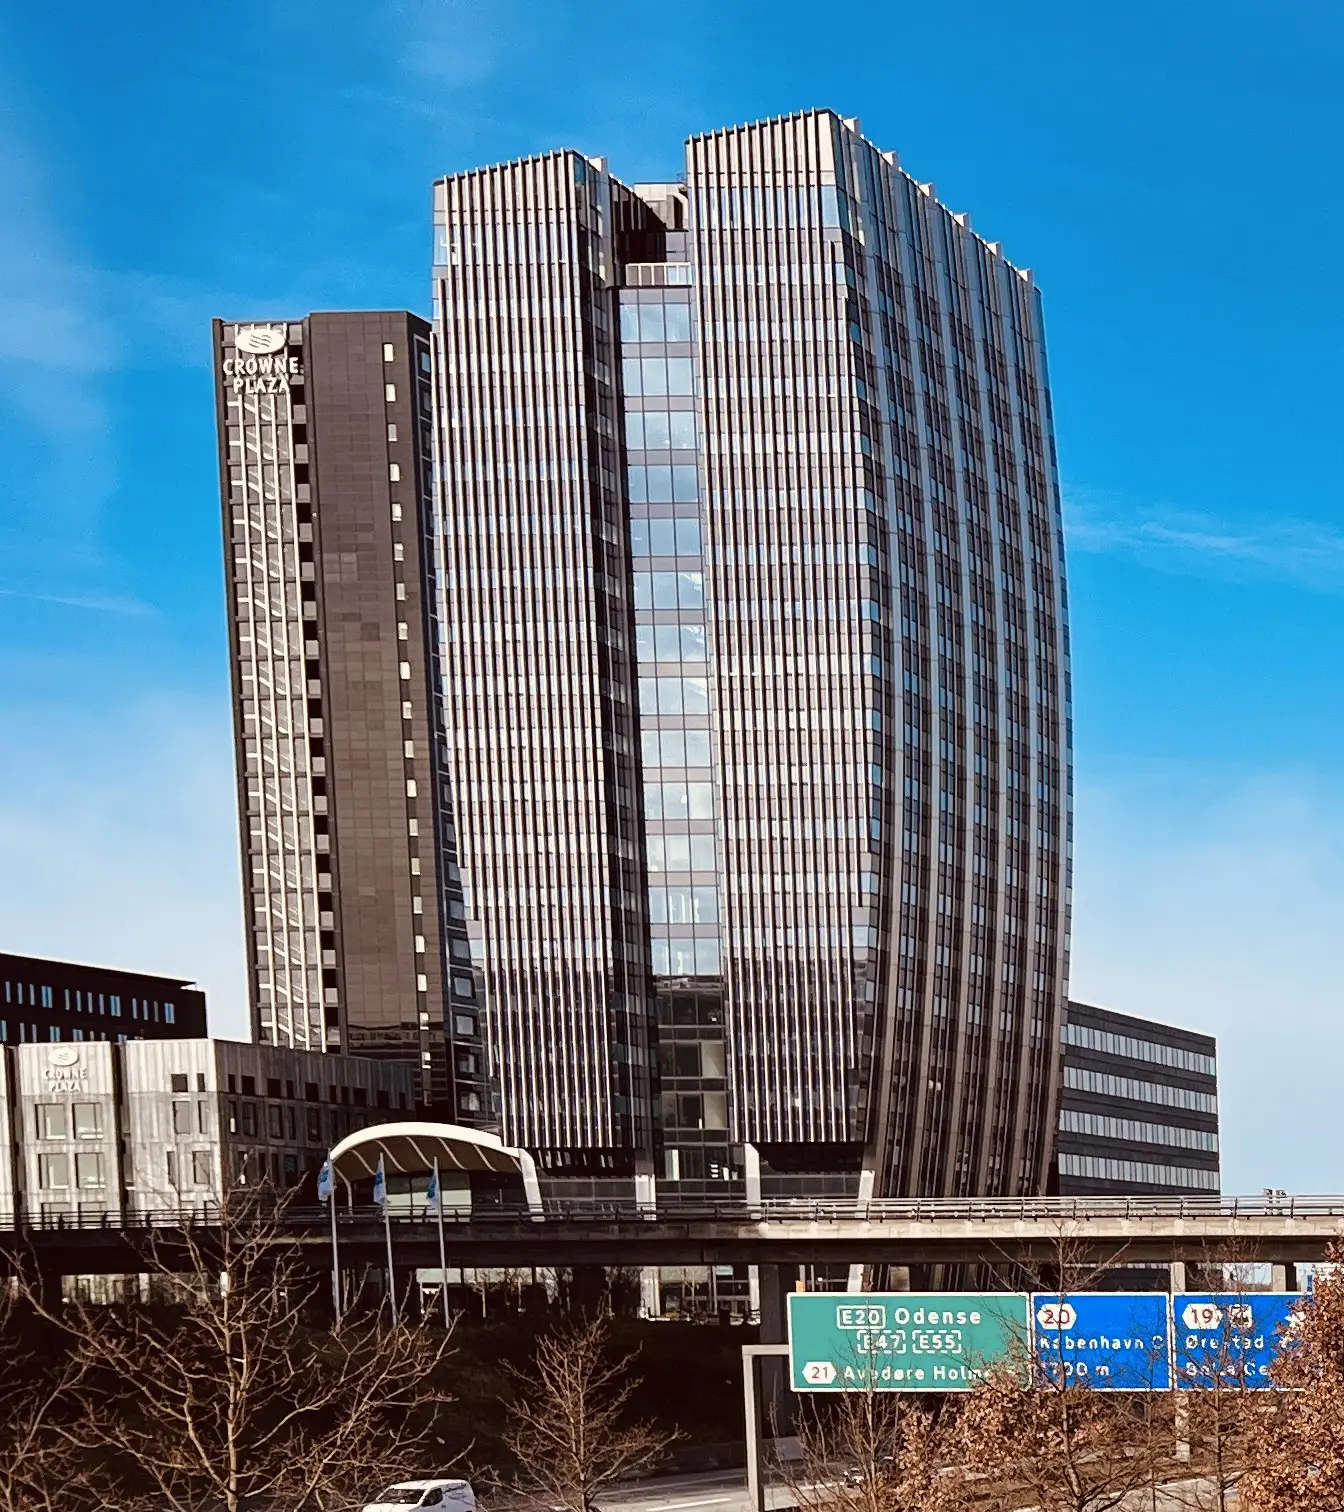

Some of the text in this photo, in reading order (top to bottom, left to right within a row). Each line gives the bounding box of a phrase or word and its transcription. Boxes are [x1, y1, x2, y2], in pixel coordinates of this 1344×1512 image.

[223, 357, 299, 375] CROWNE
[233, 376, 290, 394] PLAZA
[842, 1308, 981, 1325] E20 Odense
[1044, 1309, 1071, 1325] 20
[1192, 1309, 1213, 1325] 19
[863, 1335, 900, 1350] E47
[919, 1335, 956, 1350] E55
[1186, 1335, 1264, 1350] Øretad
[811, 1366, 829, 1379] 21
